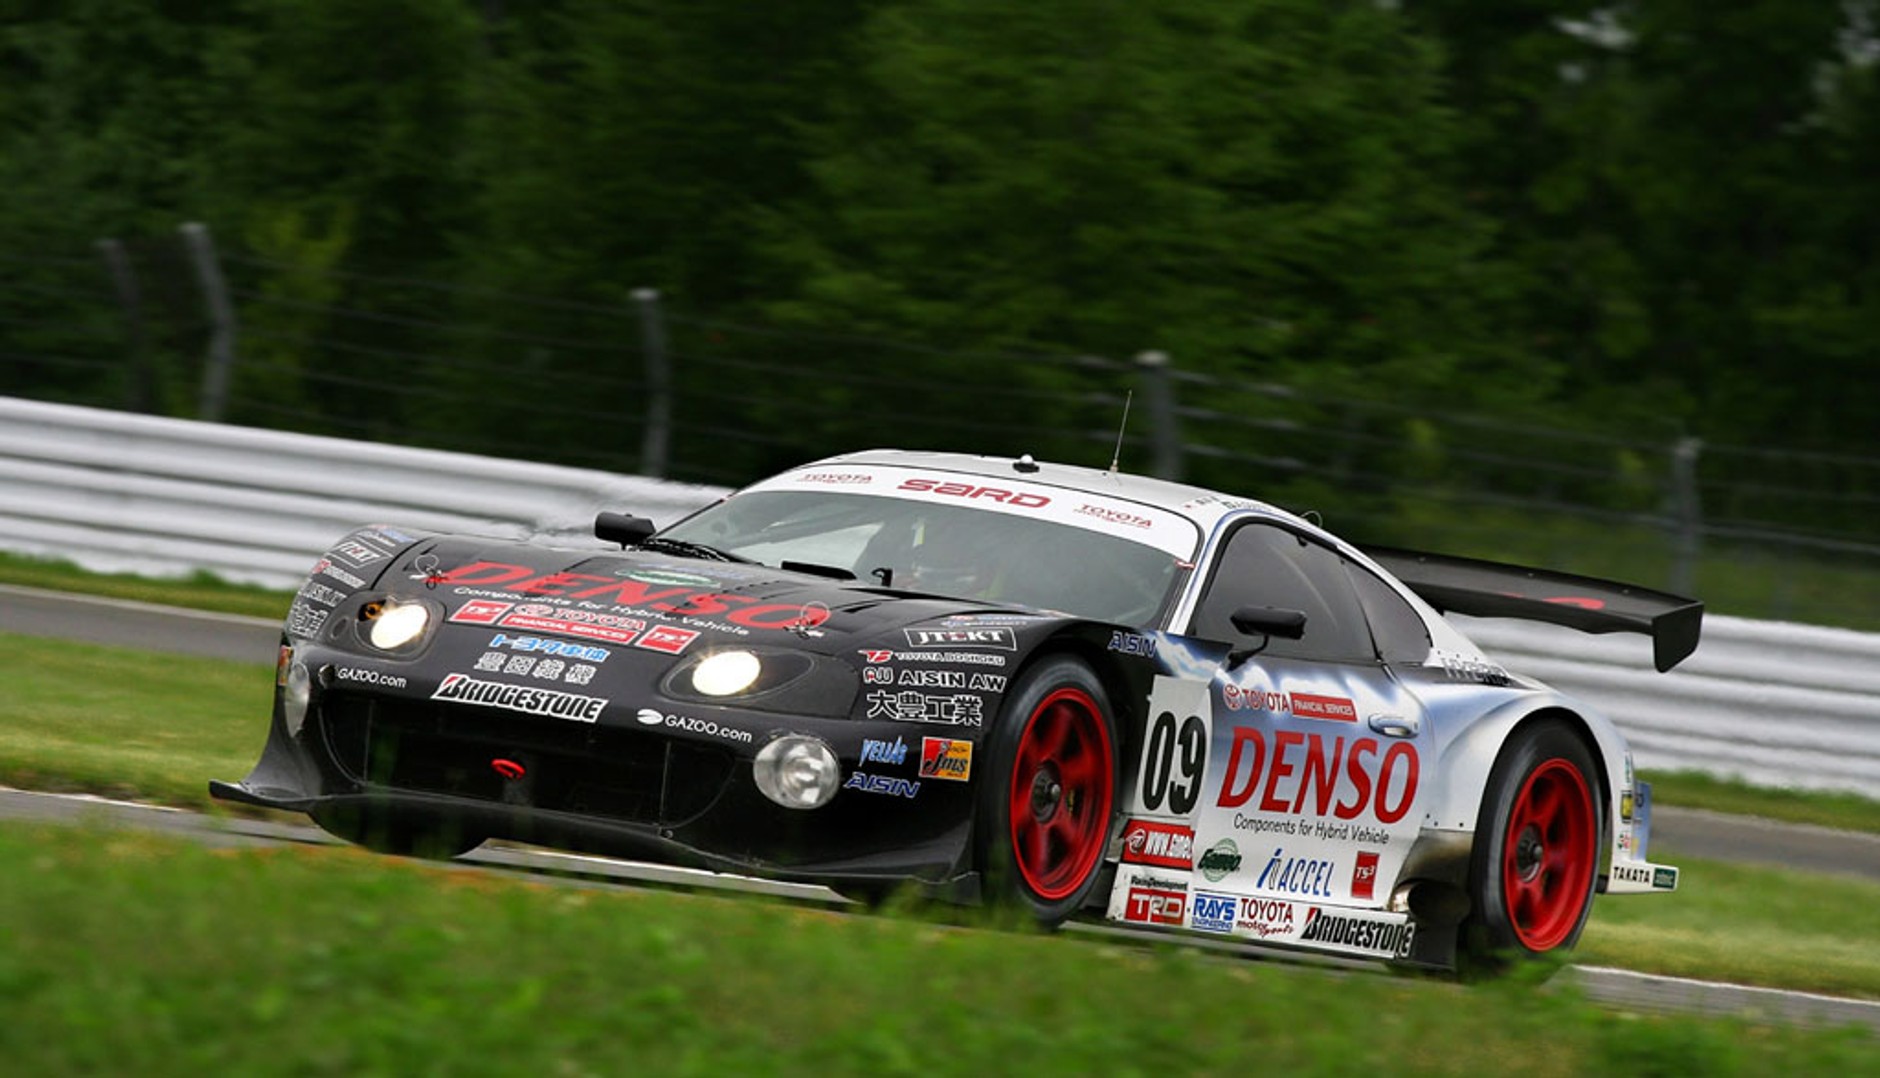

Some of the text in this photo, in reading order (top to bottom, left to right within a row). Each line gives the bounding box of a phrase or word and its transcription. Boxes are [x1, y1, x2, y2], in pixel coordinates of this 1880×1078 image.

[897, 479, 1052, 508] SARD
[1081, 504, 1152, 527] TOYOTA
[426, 560, 832, 630] DENSO
[508, 616, 629, 640] FINANCIAL SERVICES
[553, 608, 646, 631] TOYOTA
[577, 600, 607, 610] for
[682, 617, 750, 636] Vehicle
[918, 629, 1004, 645] JTEKT
[1107, 630, 1157, 658] AISIN
[337, 668, 407, 689] GAZOO.com
[898, 669, 965, 688] AISIN
[969, 673, 1007, 692] AW
[435, 675, 604, 721] BRIDGESTONE
[867, 690, 983, 726] 大豊工業
[1242, 689, 1354, 716] TOYOTA FINANCIAL SERVICES
[665, 714, 752, 743] GAZOO.com
[1143, 711, 1206, 814] 09
[1217, 726, 1420, 824] DENSO
[843, 771, 921, 798] AISIN
[1234, 812, 1389, 845] Components for Hybrid Vehicle
[1613, 866, 1650, 884] TAKATA
[1131, 893, 1183, 922] TRD
[1194, 897, 1236, 920] RAYS
[1241, 898, 1293, 922] TOYOTA
[1300, 906, 1416, 955] BRIDGESTONE
